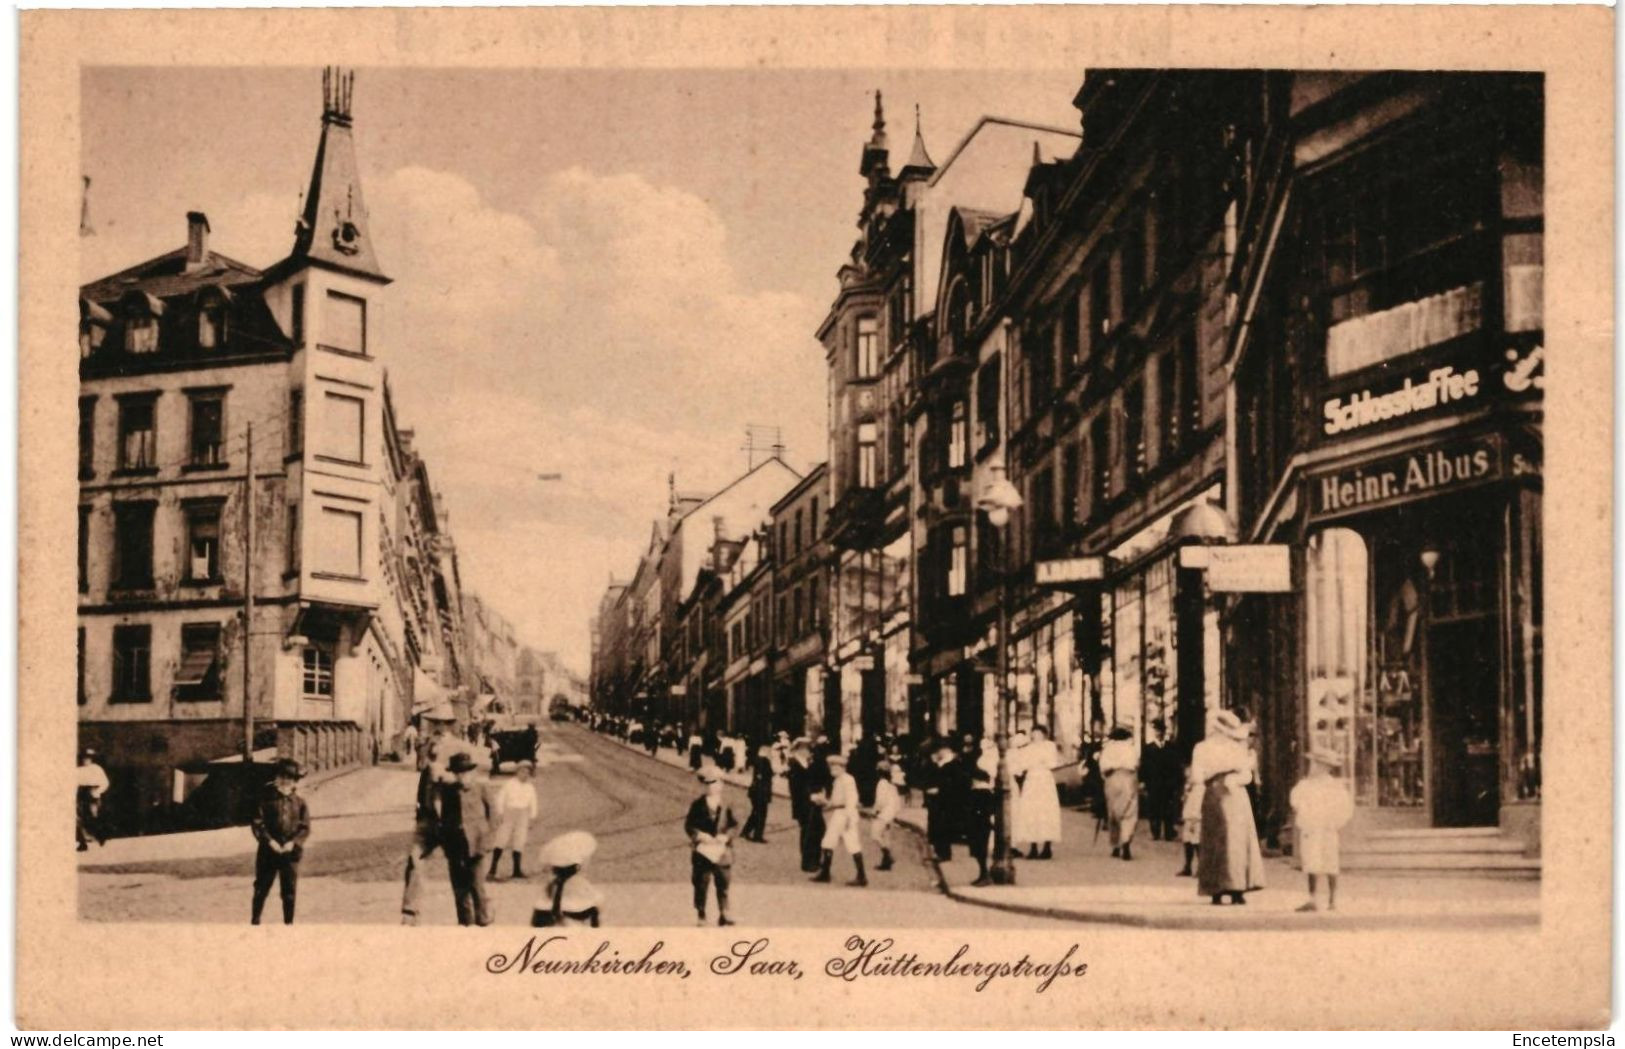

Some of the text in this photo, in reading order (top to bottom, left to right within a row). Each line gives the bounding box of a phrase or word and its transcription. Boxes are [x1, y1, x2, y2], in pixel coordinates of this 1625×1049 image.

[1324, 366, 1480, 435] Schlosskaffee
[1321, 470, 1399, 511] Heinr.
[1403, 450, 1489, 493] Albus
